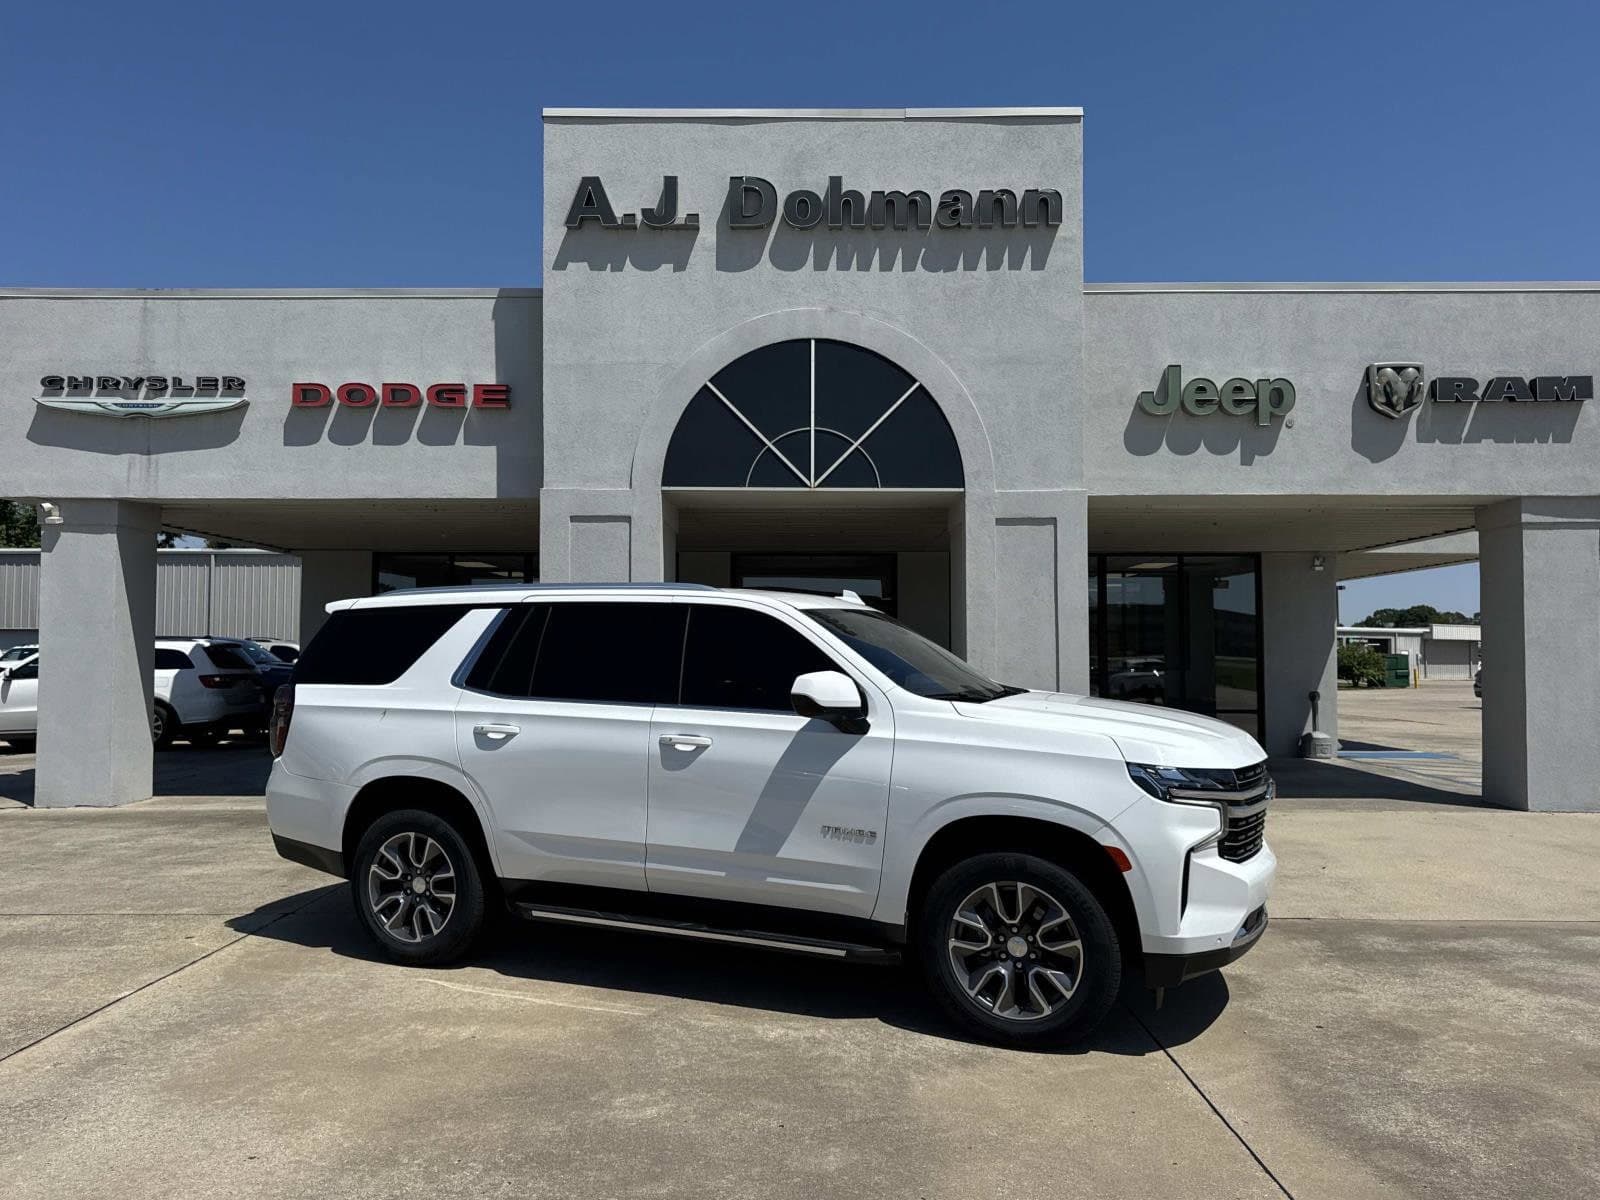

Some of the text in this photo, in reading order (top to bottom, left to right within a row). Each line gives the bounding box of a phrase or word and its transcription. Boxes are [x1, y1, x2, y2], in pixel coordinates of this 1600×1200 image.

[565, 175, 1063, 230] A.J. Dohmann
[40, 375, 246, 392] CHRYSLER
[291, 382, 512, 408] DODGE
[1141, 365, 1296, 427] Jeep
[1432, 376, 1594, 402] RAM
